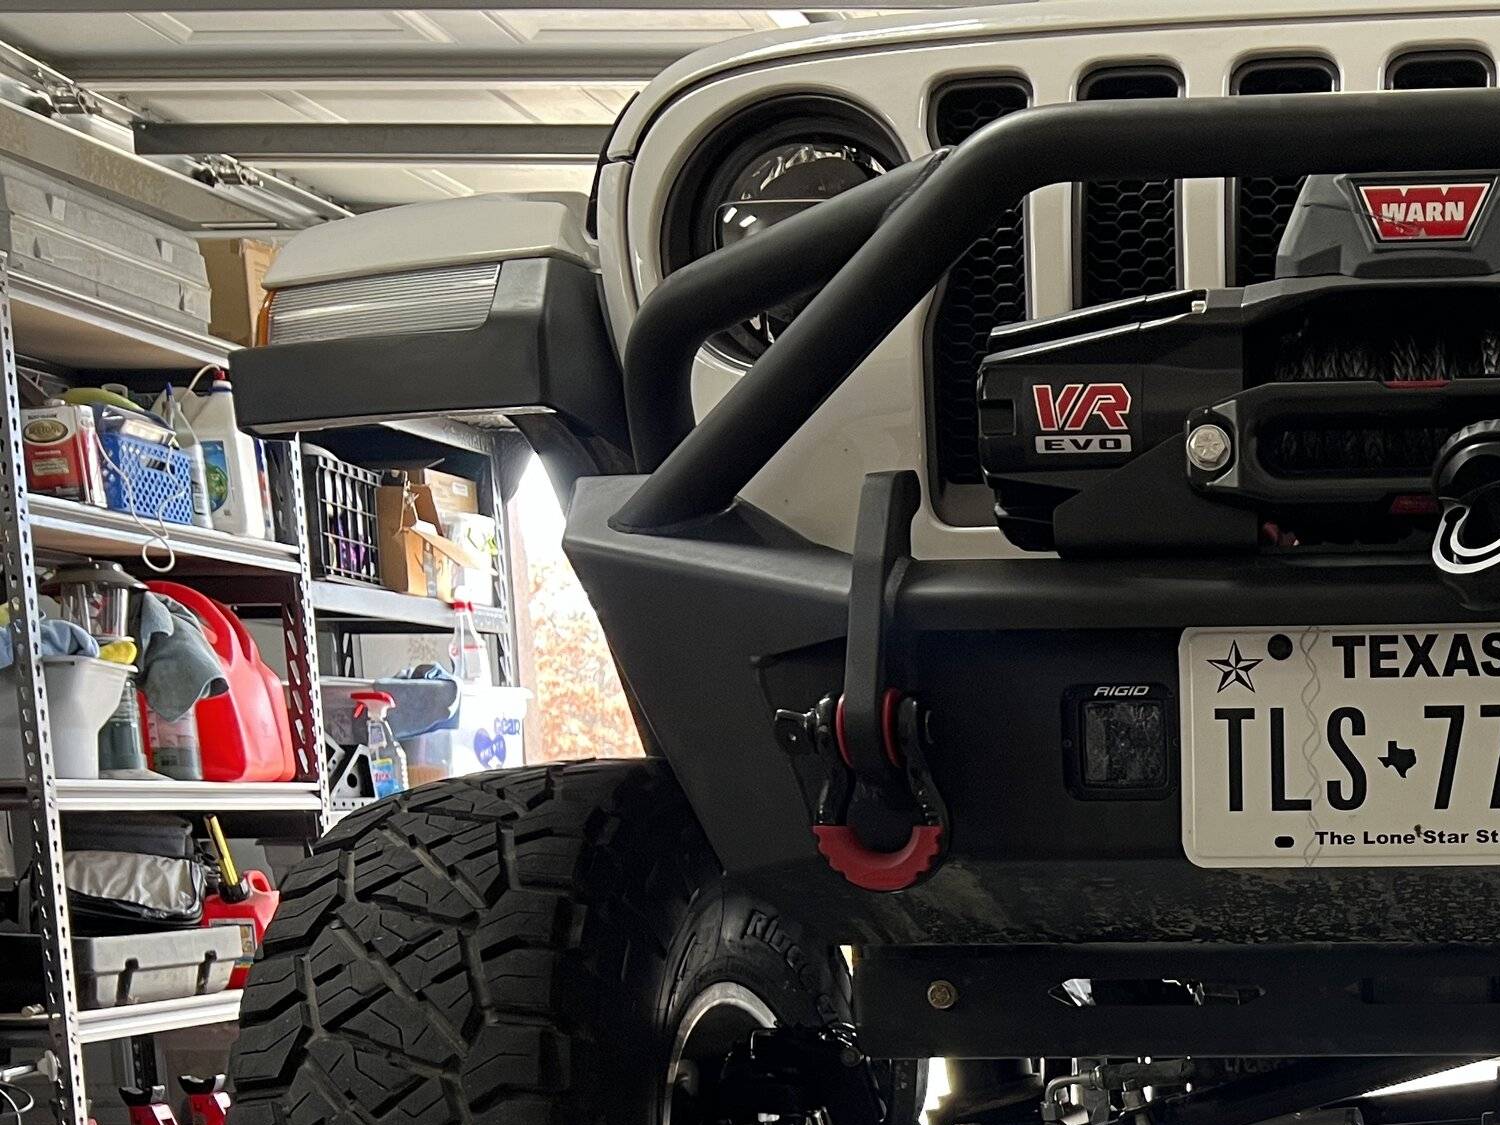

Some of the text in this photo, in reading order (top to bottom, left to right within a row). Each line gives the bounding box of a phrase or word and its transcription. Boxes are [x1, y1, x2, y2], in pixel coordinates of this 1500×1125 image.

[1381, 201, 1465, 223] WARN
[1033, 383, 1131, 431] VR
[1044, 438, 1122, 451] EVO
[1094, 685, 1150, 697] RIGID
[1214, 706, 1368, 812] TLS
[1314, 831, 1356, 846] The
[1363, 830, 1416, 845] Lone
[1422, 829, 1470, 844] Star
